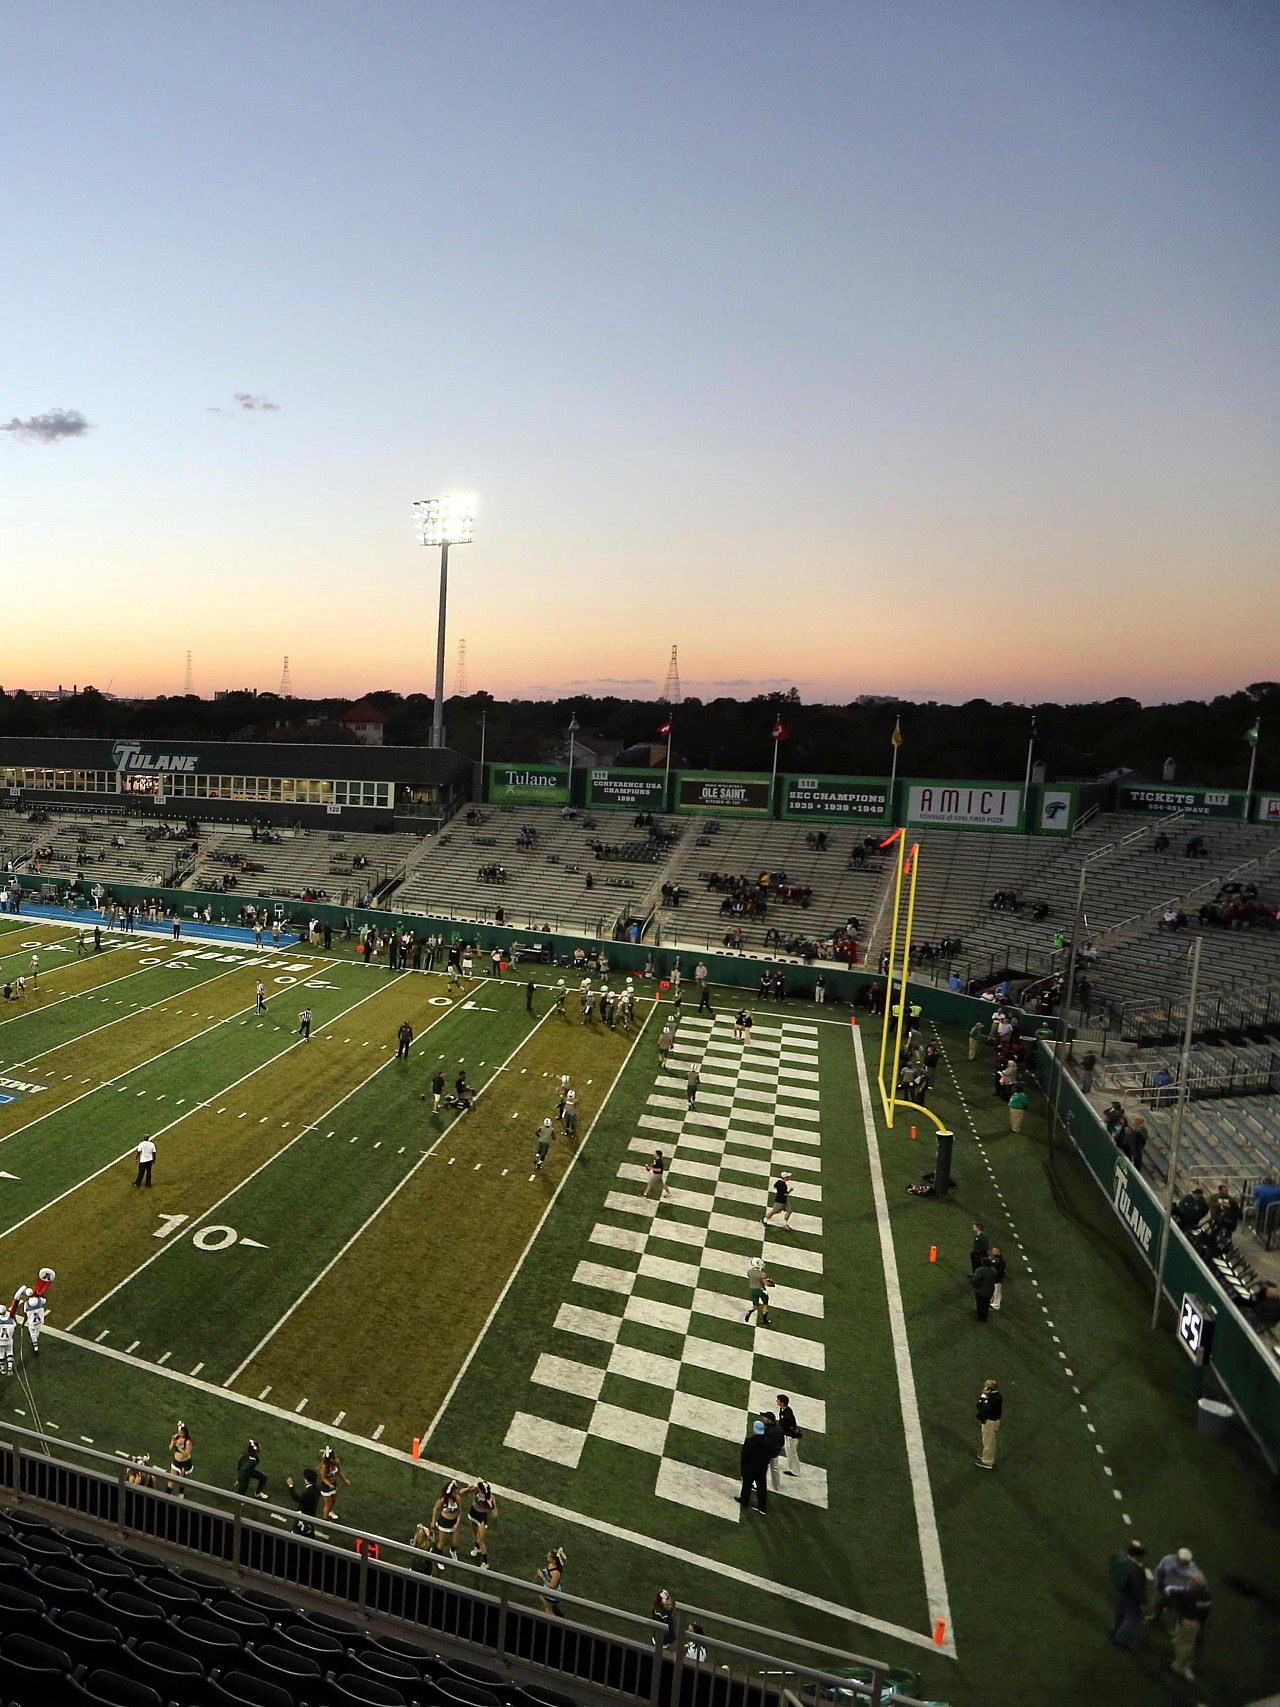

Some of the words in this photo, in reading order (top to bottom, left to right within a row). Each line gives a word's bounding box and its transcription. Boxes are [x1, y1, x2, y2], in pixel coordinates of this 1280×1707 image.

[114, 745, 199, 771] TULANE
[505, 771, 557, 787] Tulane
[593, 781, 644, 789] CONFERENCE
[604, 787, 651, 795] CHAMPIONS
[702, 787, 718, 798] OLE
[719, 788, 746, 799] SAINT
[789, 791, 811, 800] SEC
[813, 792, 885, 803] CHAMPIONS
[1129, 791, 1195, 804] TICKETS
[920, 788, 1006, 815] AMICI
[1209, 795, 1226, 804] 117
[789, 801, 814, 809] 1935
[824, 803, 849, 811] 1939
[857, 805, 883, 813] 1949
[273, 976, 332, 989] 20
[427, 996, 480, 1010] 10
[1114, 1165, 1153, 1252] TULANE
[152, 1213, 238, 1250] 10
[1181, 1302, 1201, 1352] 25
